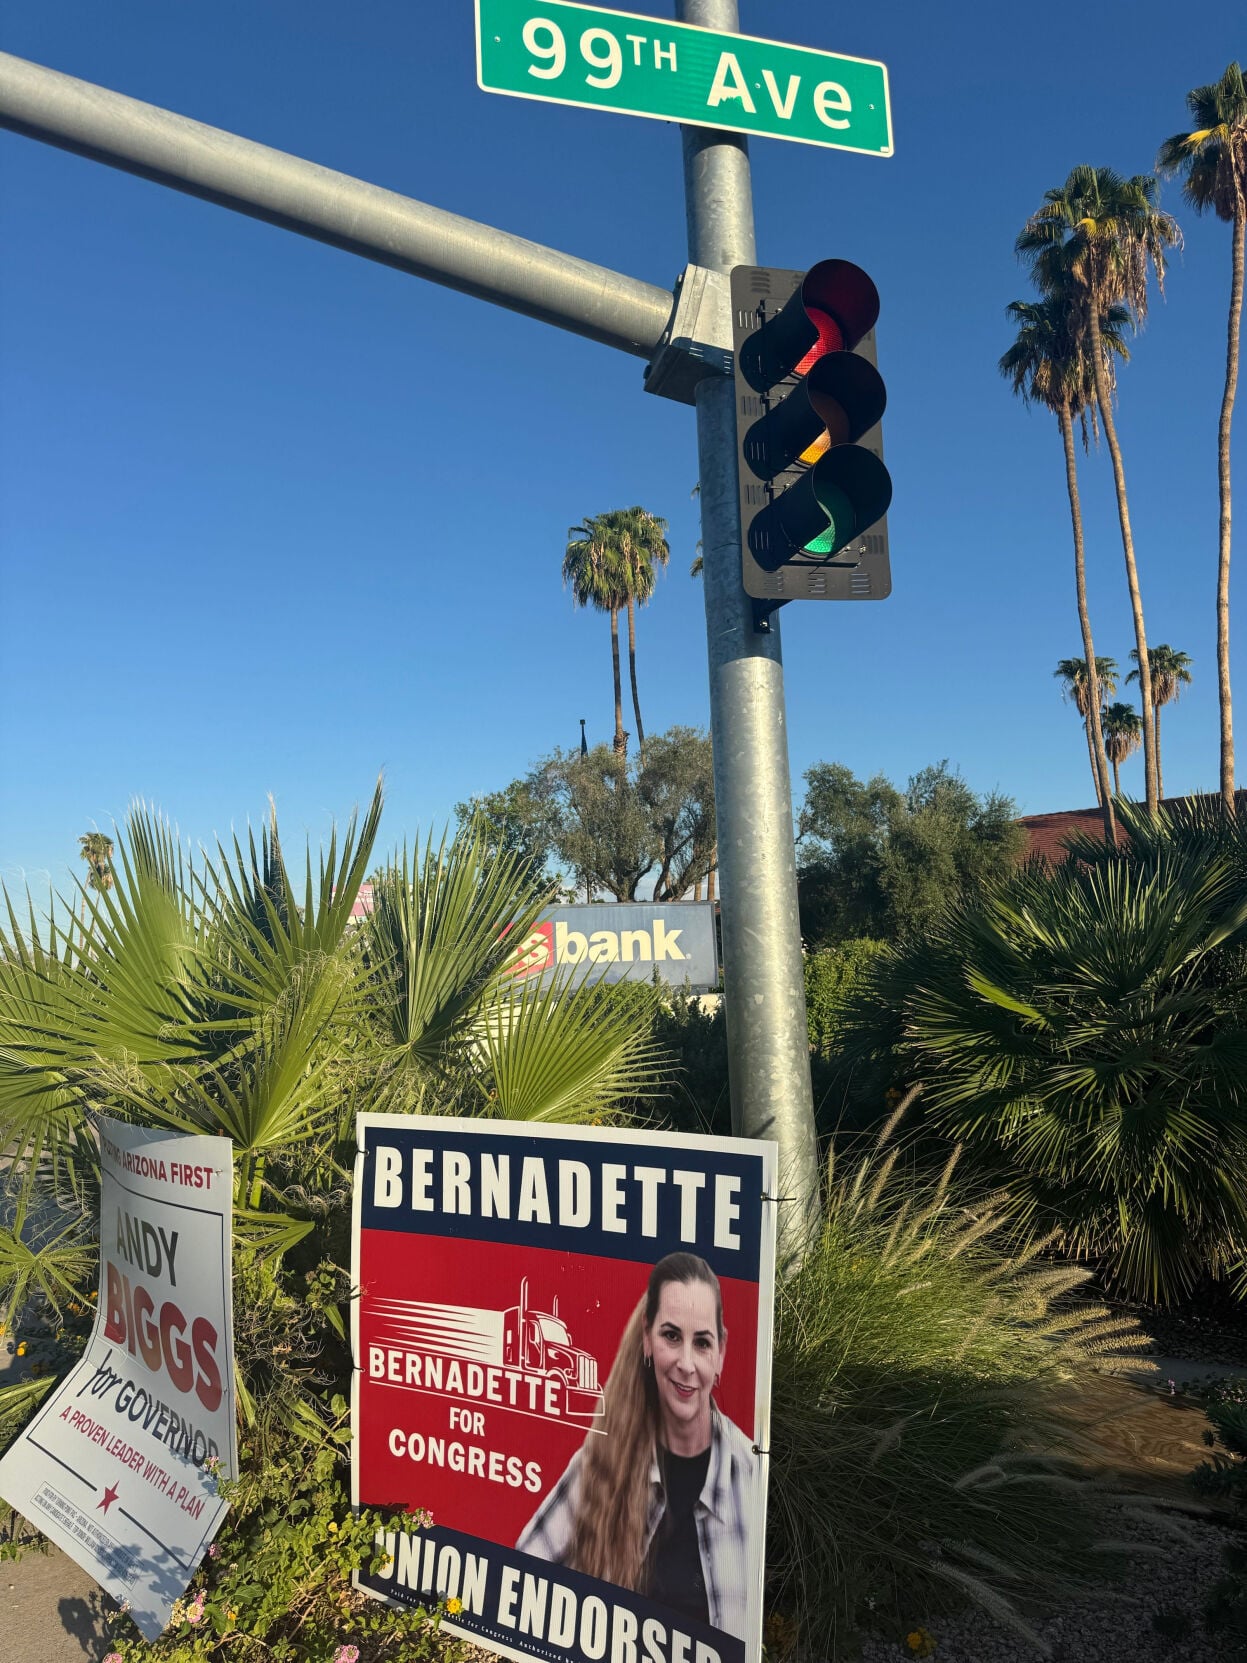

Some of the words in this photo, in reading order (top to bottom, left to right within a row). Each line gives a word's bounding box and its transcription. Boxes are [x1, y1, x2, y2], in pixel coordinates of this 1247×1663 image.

[521, 17, 678, 89] 99TH
[706, 51, 853, 130] Ave
[122, 1150, 168, 1182] ARIZONA
[170, 1162, 213, 1190] FIRST
[373, 1145, 741, 1251] BERNADETTE
[116, 1206, 179, 1287] ANDY
[104, 1260, 223, 1413] BIGGS
[369, 1347, 561, 1416] BERNADETTE
[449, 1406, 485, 1437] FOR
[59, 1405, 72, 1421] A
[68, 1410, 111, 1447] PROVEN
[105, 1435, 145, 1474] LEADER
[142, 1459, 171, 1493] WITH
[166, 1480, 178, 1500] A
[175, 1486, 206, 1521] PLAN
[388, 1428, 543, 1493] CONGRESS
[375, 1526, 489, 1617] UNION
[481, 1625, 513, 1643] Congress
[519, 1640, 562, 1661] Authorized
